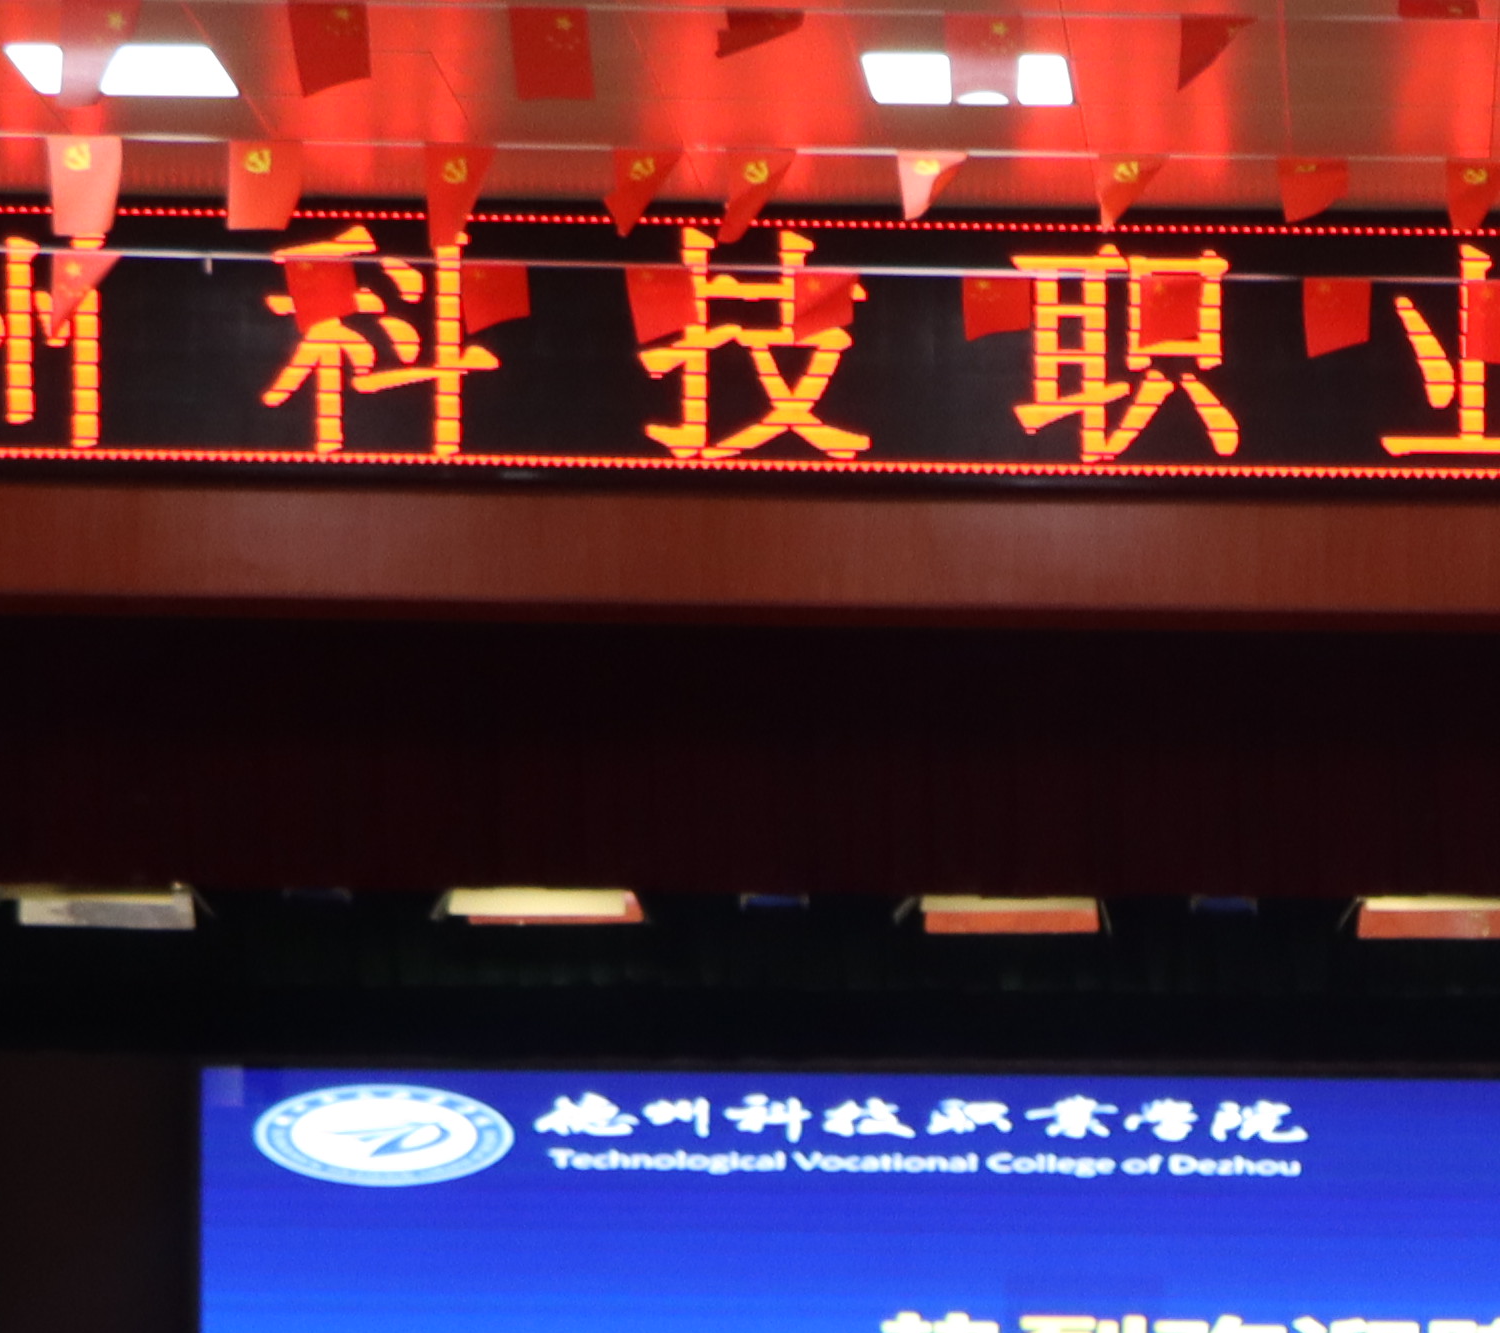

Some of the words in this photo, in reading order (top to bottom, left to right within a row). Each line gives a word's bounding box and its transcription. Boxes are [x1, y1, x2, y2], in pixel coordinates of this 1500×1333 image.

[549, 1147, 787, 1174] Technological
[793, 1150, 978, 1173] Vocational
[987, 1151, 1115, 1177] College
[1121, 1153, 1162, 1174] of
[1168, 1153, 1302, 1176] Dezhou
